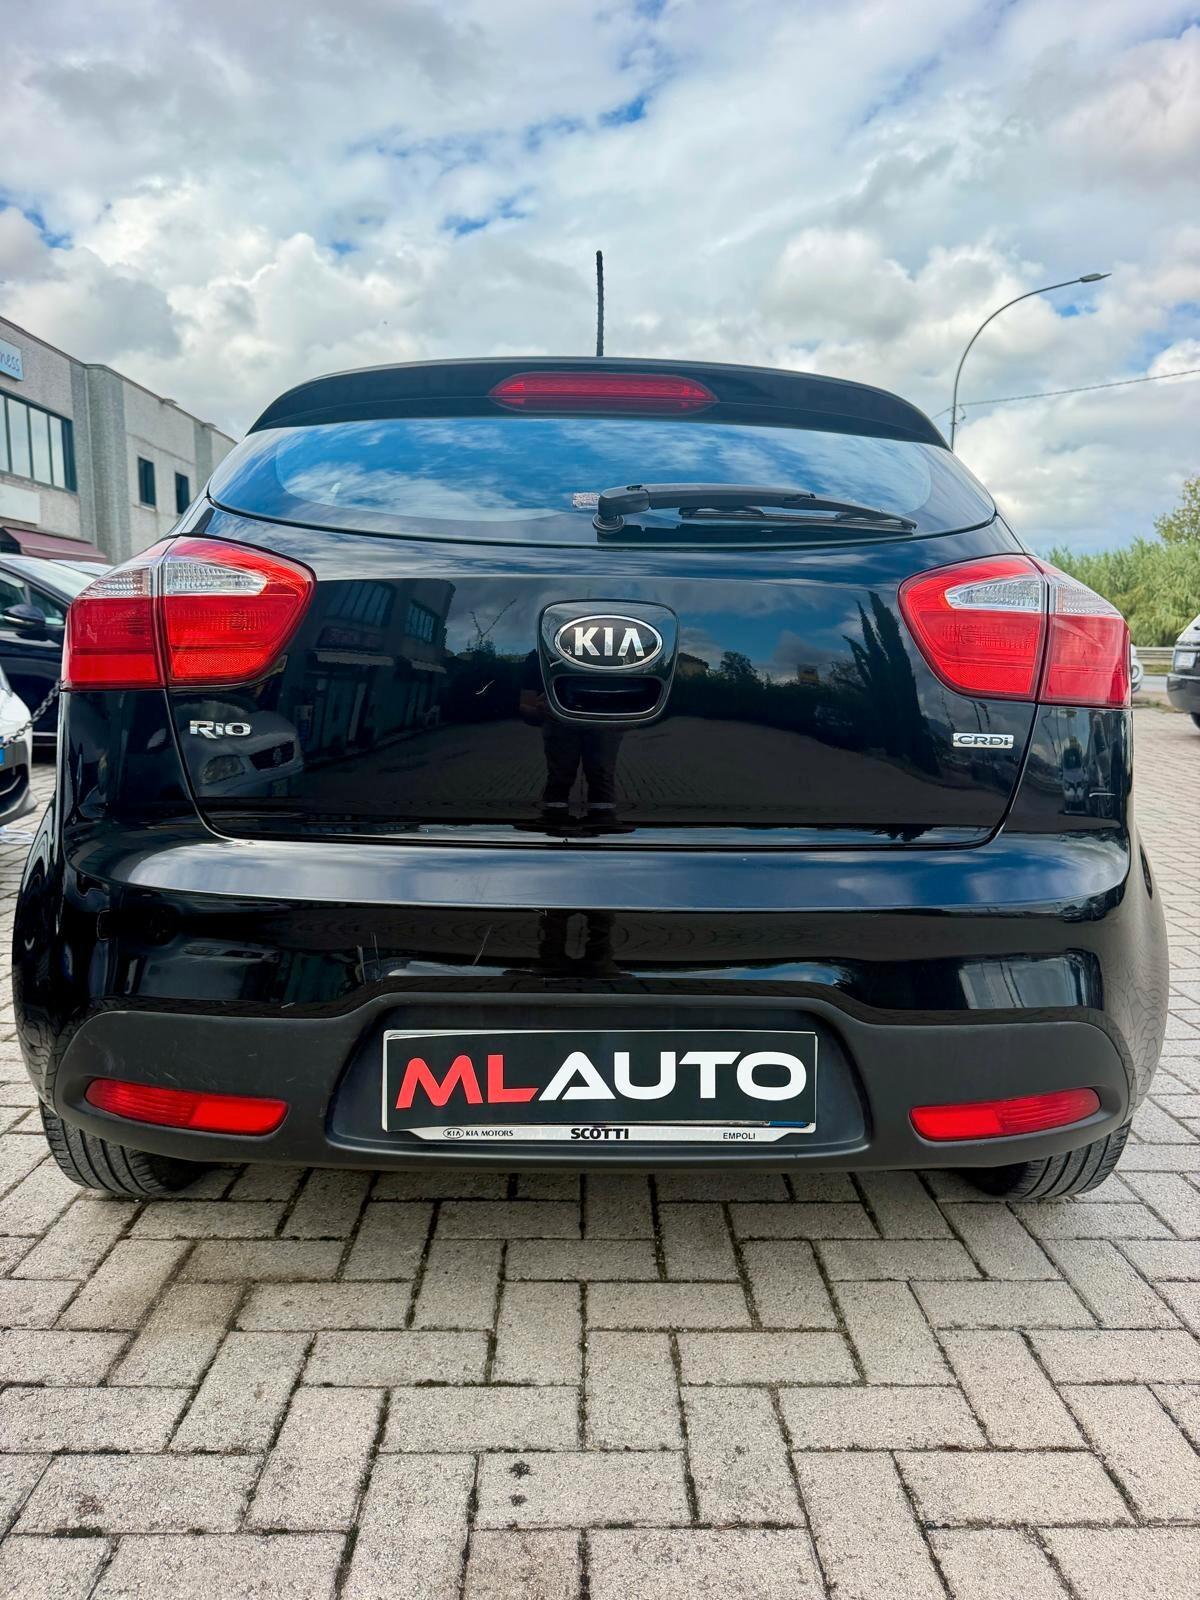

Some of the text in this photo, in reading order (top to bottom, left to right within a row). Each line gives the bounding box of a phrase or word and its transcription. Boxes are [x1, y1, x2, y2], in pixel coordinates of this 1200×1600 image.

[574, 626, 645, 657] KIA
[957, 735, 1009, 746] CRDi
[480, 1129, 514, 1137] MOTORS
[570, 1127, 629, 1140] SCOTTI
[722, 1132, 756, 1140] EMPOLI
